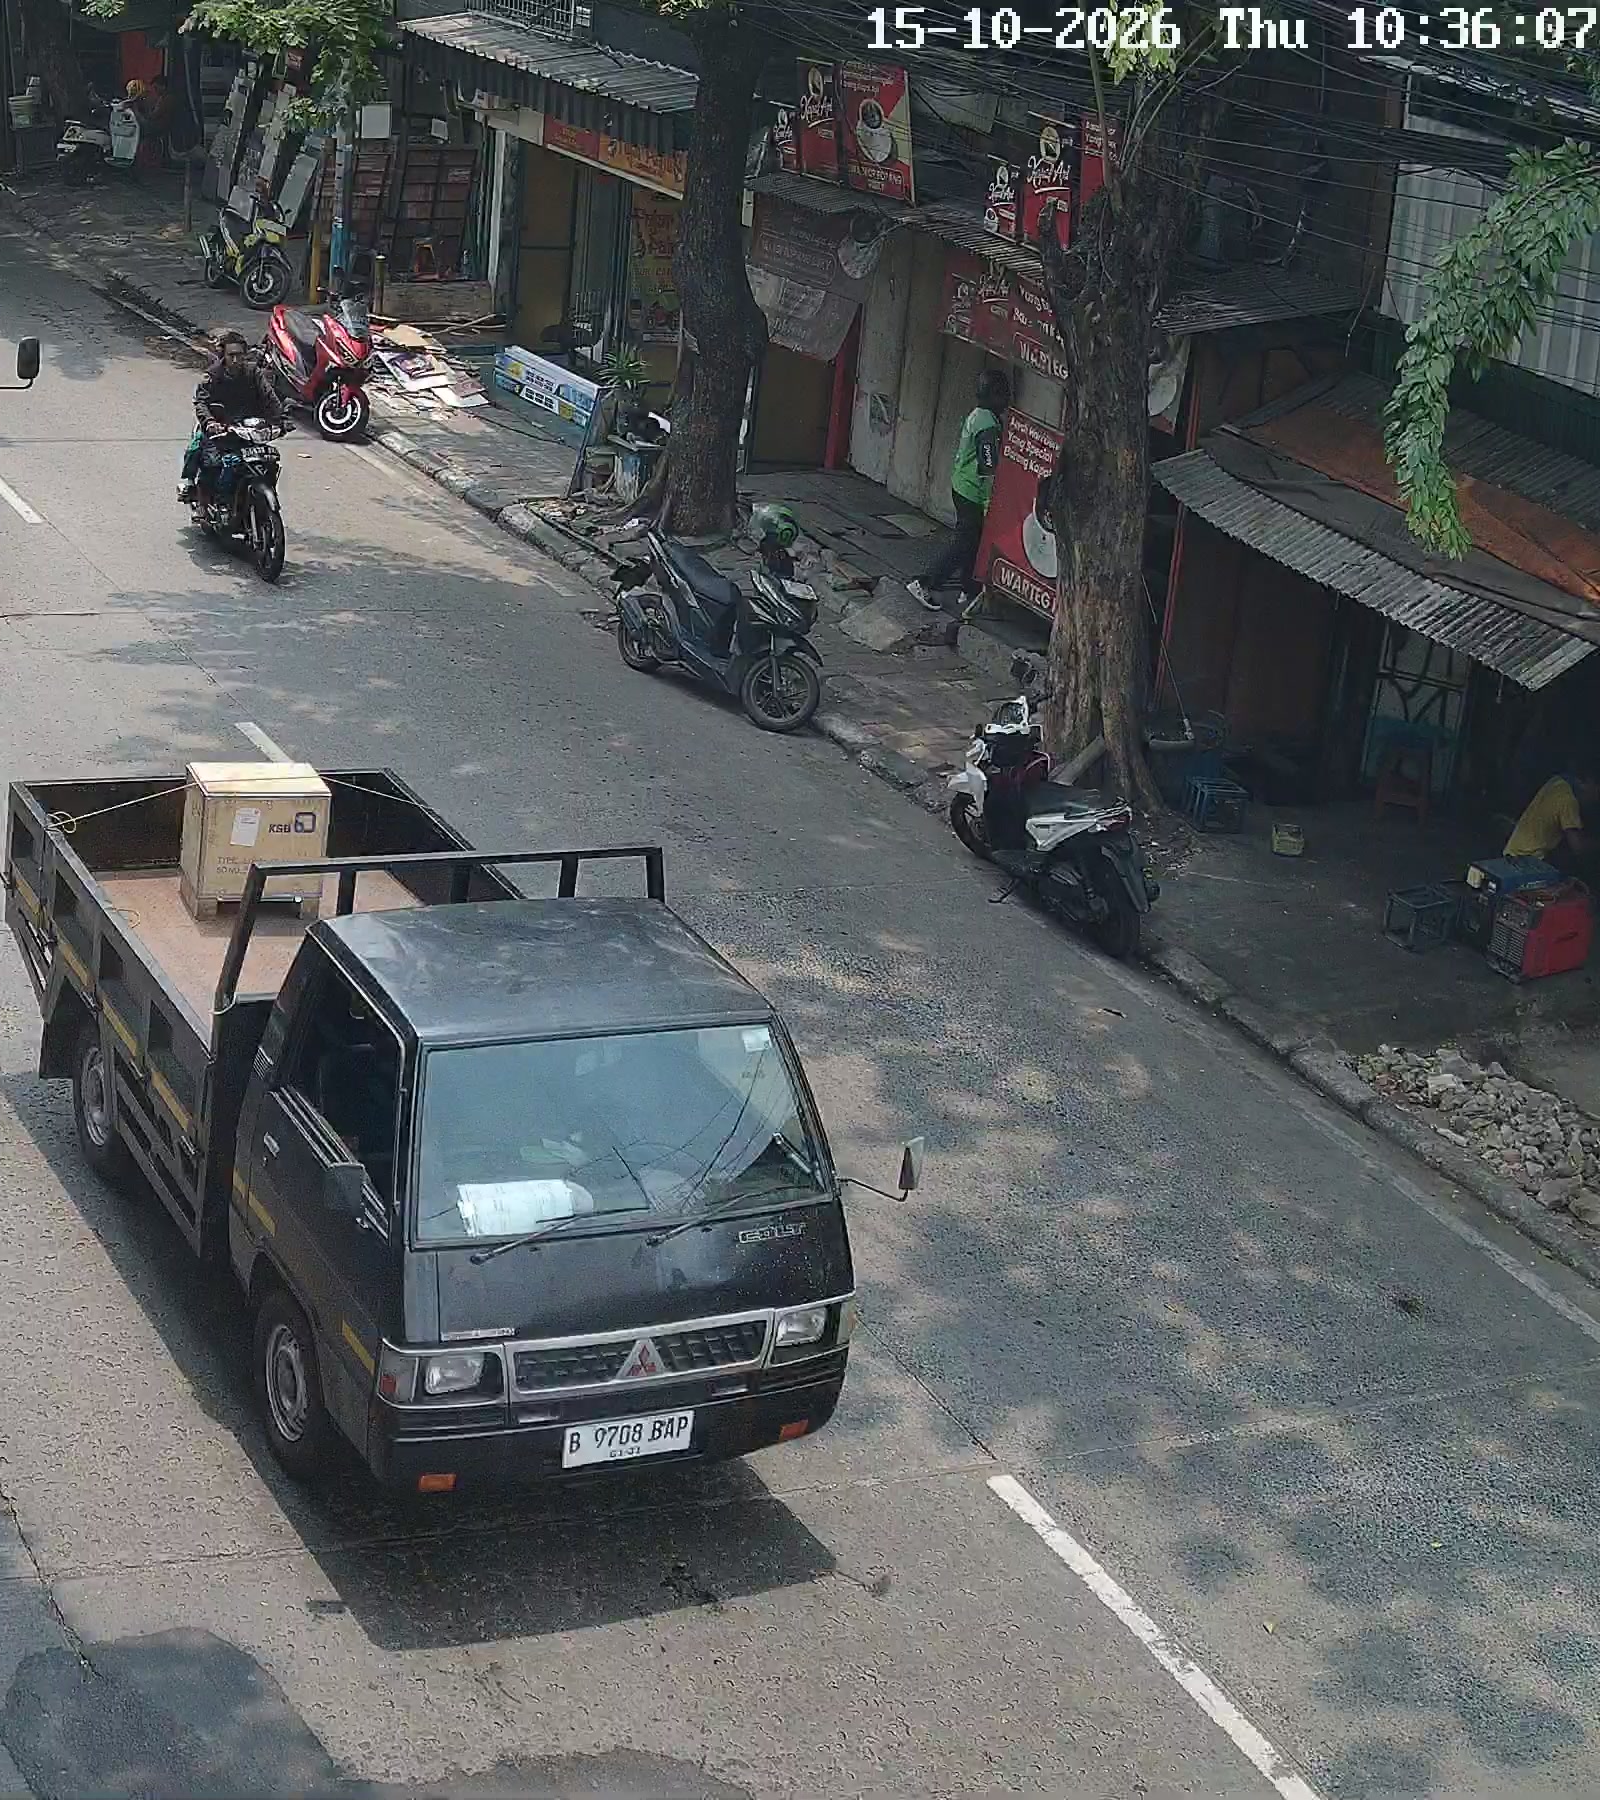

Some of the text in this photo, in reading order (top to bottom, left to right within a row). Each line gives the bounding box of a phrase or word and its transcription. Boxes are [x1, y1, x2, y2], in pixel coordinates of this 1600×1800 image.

[1000, 567, 1051, 609] WARTEG
[268, 823, 292, 833] KSB
[569, 1416, 689, 1453] B 9708 BAP
